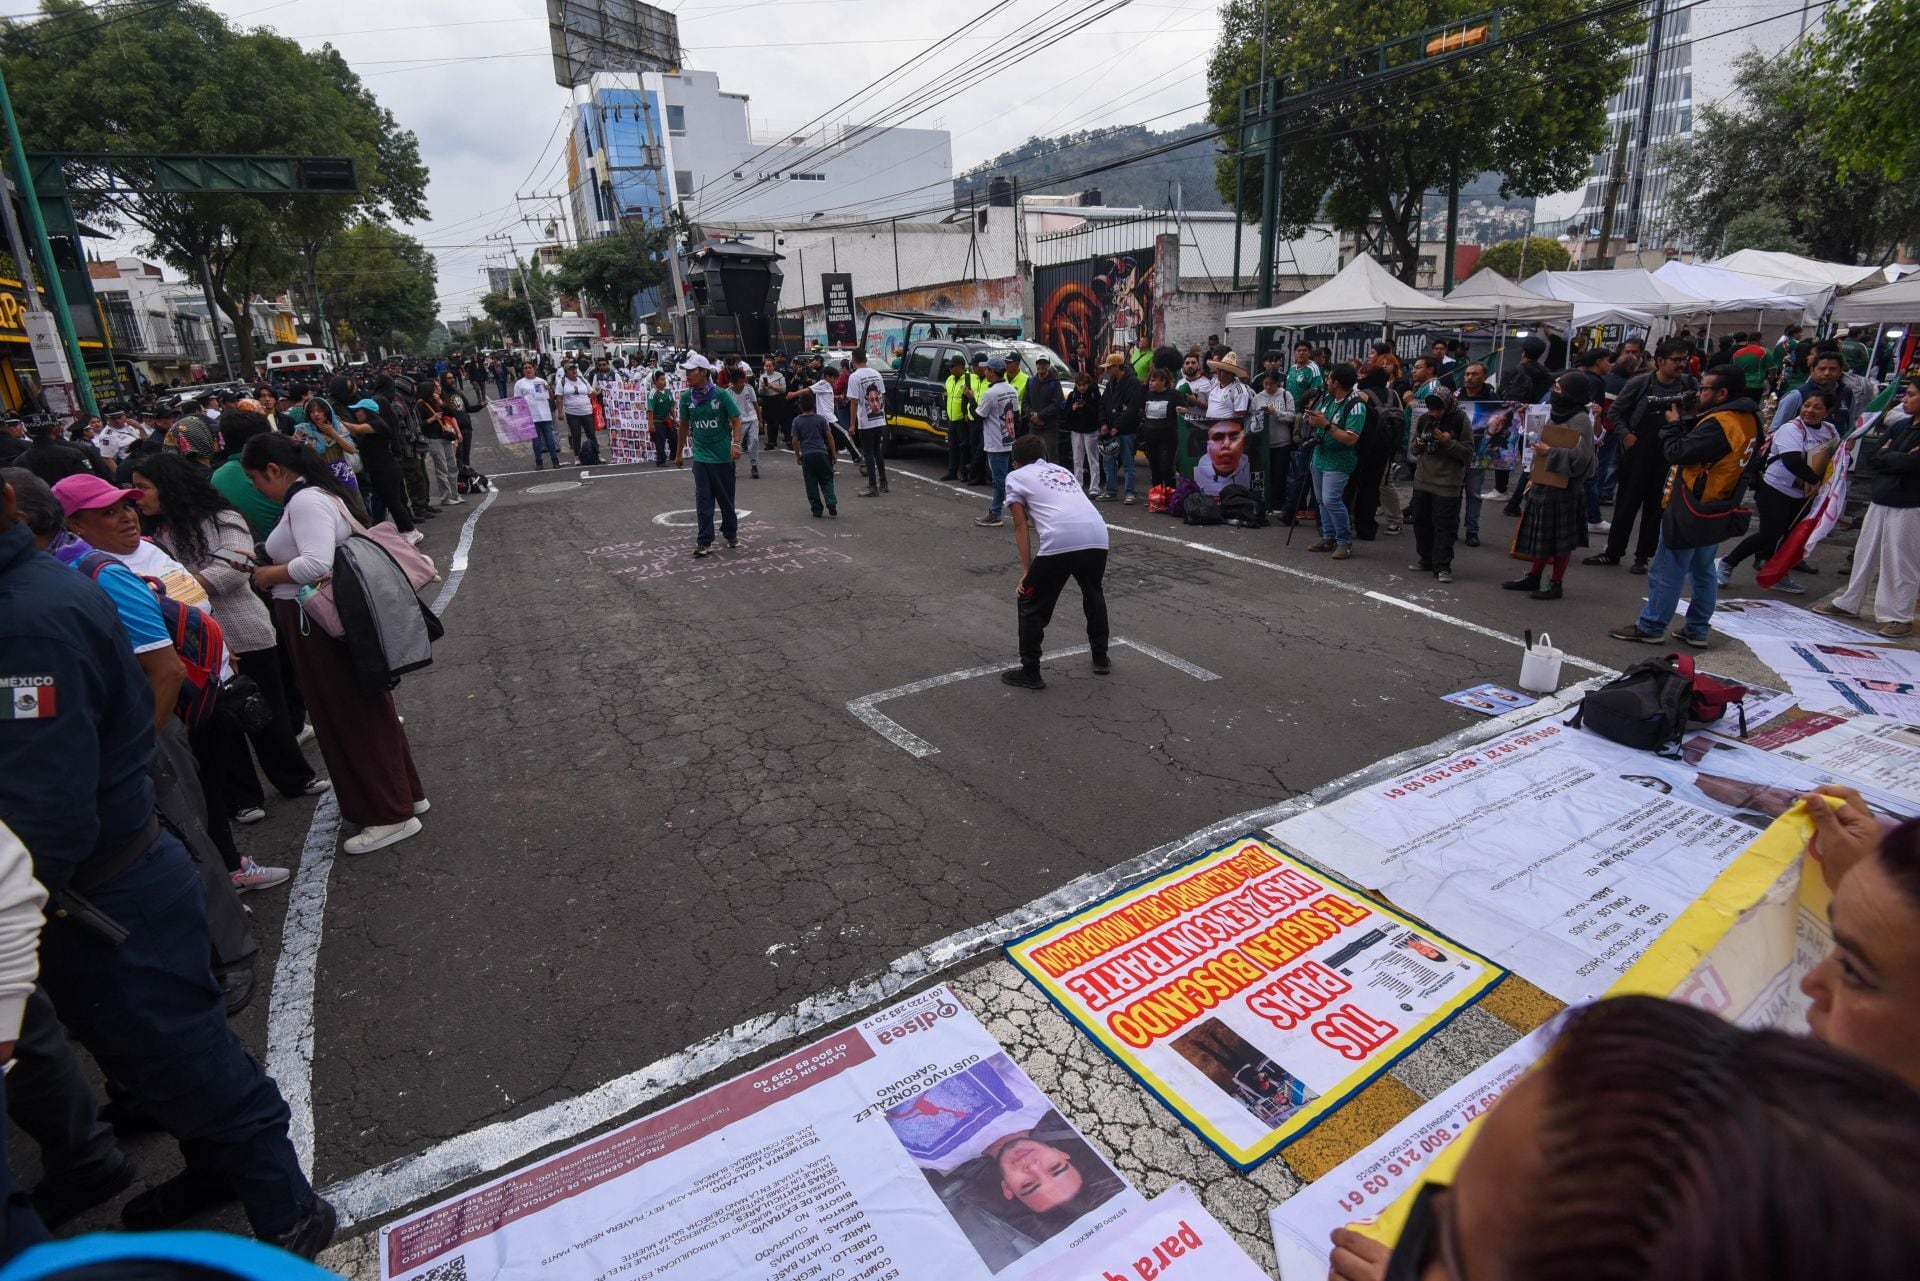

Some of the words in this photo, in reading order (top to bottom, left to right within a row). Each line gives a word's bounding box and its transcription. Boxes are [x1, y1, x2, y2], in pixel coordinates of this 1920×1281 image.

[904, 404, 928, 417] POLICÍA
[1739, 437, 1757, 468] 5
[0, 676, 54, 688] MÉXICO
[1483, 749, 1502, 759] 27
[1448, 759, 1476, 772] 800
[1422, 770, 1451, 783] 216
[1383, 788, 1405, 798] 61
[1402, 781, 1425, 791] 03
[1159, 863, 1246, 911] ALEJANDRO
[1233, 870, 1320, 916] HASTA
[1121, 895, 1179, 930] CRUZ
[1310, 894, 1369, 925] TE
[1030, 912, 1142, 976] MONDRAGON
[1237, 909, 1339, 969] SIGUEN
[1068, 902, 1257, 1009] ENCONTRARTE
[1600, 939, 1630, 959] OSCURO
[1108, 950, 1264, 1046] BUSCANDO
[1247, 962, 1349, 1028] PAPAS
[874, 1013, 888, 1023] 20
[888, 1005, 909, 1018] 283
[862, 1021, 874, 1029] 12
[1312, 1005, 1396, 1059] TUS
[811, 1048, 836, 1062] 800
[834, 1043, 846, 1051] 01
[795, 1059, 809, 1069] 89
[815, 1051, 845, 1066] LADA
[771, 1067, 793, 1081] 029
[800, 1064, 817, 1076] SIN
[922, 1054, 983, 1086] GUSTAVO
[753, 1079, 768, 1088] 40
[762, 1074, 798, 1092] COSTO
[876, 1063, 939, 1096] GARDUÑO
[854, 1084, 926, 1122] GONZÁLEZ
[1452, 1101, 1464, 1109] DE
[1426, 1108, 1455, 1129] PERSONAS
[780, 1134, 797, 1145] REY
[1417, 1126, 1428, 1135] EN
[762, 1141, 781, 1154] CON
[763, 1140, 795, 1158] BLANCO
[1388, 1138, 1412, 1157] ESTADO
[1419, 1128, 1450, 1152] 800
[765, 1137, 819, 1166] VESTIMENTA
[1378, 1155, 1390, 1164] DE
[802, 1161, 833, 1179] TATUAJE
[1387, 1148, 1421, 1176] 216
[581, 1162, 623, 1181] GENERAL
[693, 1166, 728, 1186] BLANCAS
[771, 1167, 807, 1188] TATUAJE
[787, 1176, 801, 1185] UN
[807, 1167, 837, 1185] SEÑAS
[567, 1180, 579, 1190] DE
[759, 1184, 771, 1193] EN
[806, 1175, 839, 1193] COLONIA
[814, 1181, 846, 1200] LUGAR
[1362, 1174, 1388, 1194] 03
[522, 1187, 563, 1207] JUSTICIA
[665, 1193, 685, 1206] AZUL
[724, 1196, 748, 1210] MANO
[748, 1190, 759, 1198] LA
[799, 1197, 813, 1207] DE
[814, 1191, 852, 1212] BIGOTE:
[1338, 1191, 1363, 1212] 61
[715, 1196, 768, 1223] ANTEBRAZO
[794, 1211, 809, 1222] NO
[1103, 1207, 1127, 1224] ESTADO
[460, 1214, 499, 1235] ESTADO
[605, 1214, 644, 1233] PLAYERA
[686, 1208, 727, 1230] DERECHA
[731, 1209, 772, 1234] MUNICIPIO
[824, 1210, 864, 1233] OREJAS:
[1093, 1222, 1103, 1231] DE
[444, 1234, 457, 1244] DE
[658, 1228, 684, 1244] SANTA
[719, 1231, 730, 1241] DE
[839, 1222, 870, 1241] NARIZ:
[622, 1242, 656, 1262] MUERTE
[754, 1226, 807, 1261] CUADRADO
[769, 1234, 819, 1267] MEDIANAS
[798, 1242, 831, 1263] CHATA
[830, 1234, 877, 1262] CABELLO:
[1133, 1220, 1204, 1281] para
[541, 1247, 570, 1265] PANTS
[633, 1244, 669, 1265] TATUAJE
[606, 1267, 618, 1275] EL
[619, 1262, 632, 1271] EN
[772, 1261, 798, 1281] BASE
[792, 1264, 821, 1281] NEGR
